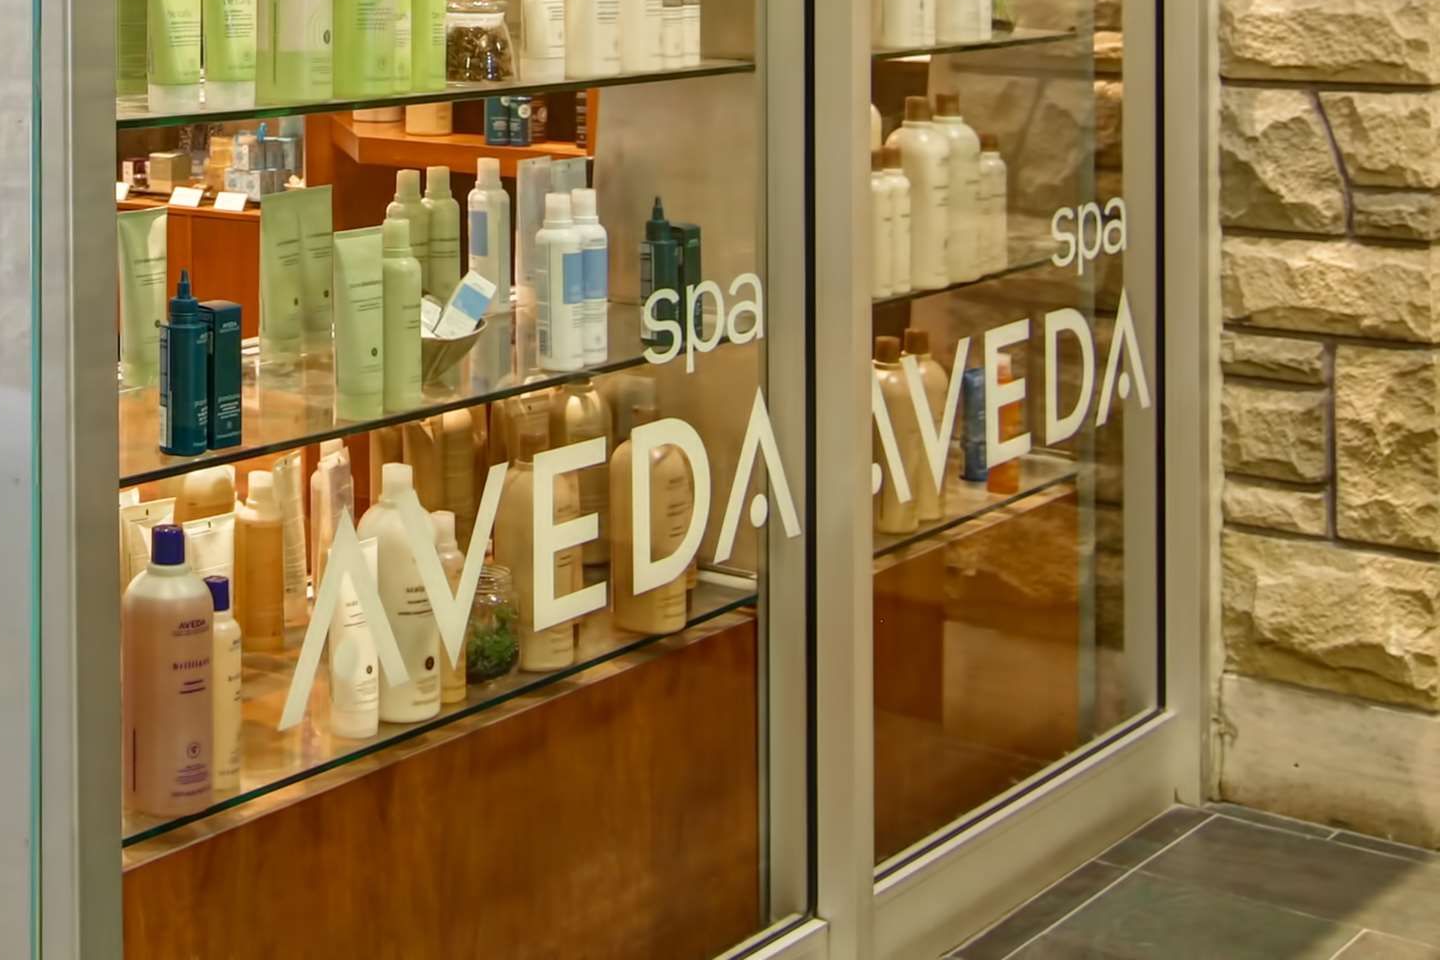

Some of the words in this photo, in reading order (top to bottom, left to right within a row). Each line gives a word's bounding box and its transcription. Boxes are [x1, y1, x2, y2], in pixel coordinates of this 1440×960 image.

[1050, 196, 1127, 276] spa
[642, 272, 764, 373] spa
[278, 386, 802, 732] AVEDA
